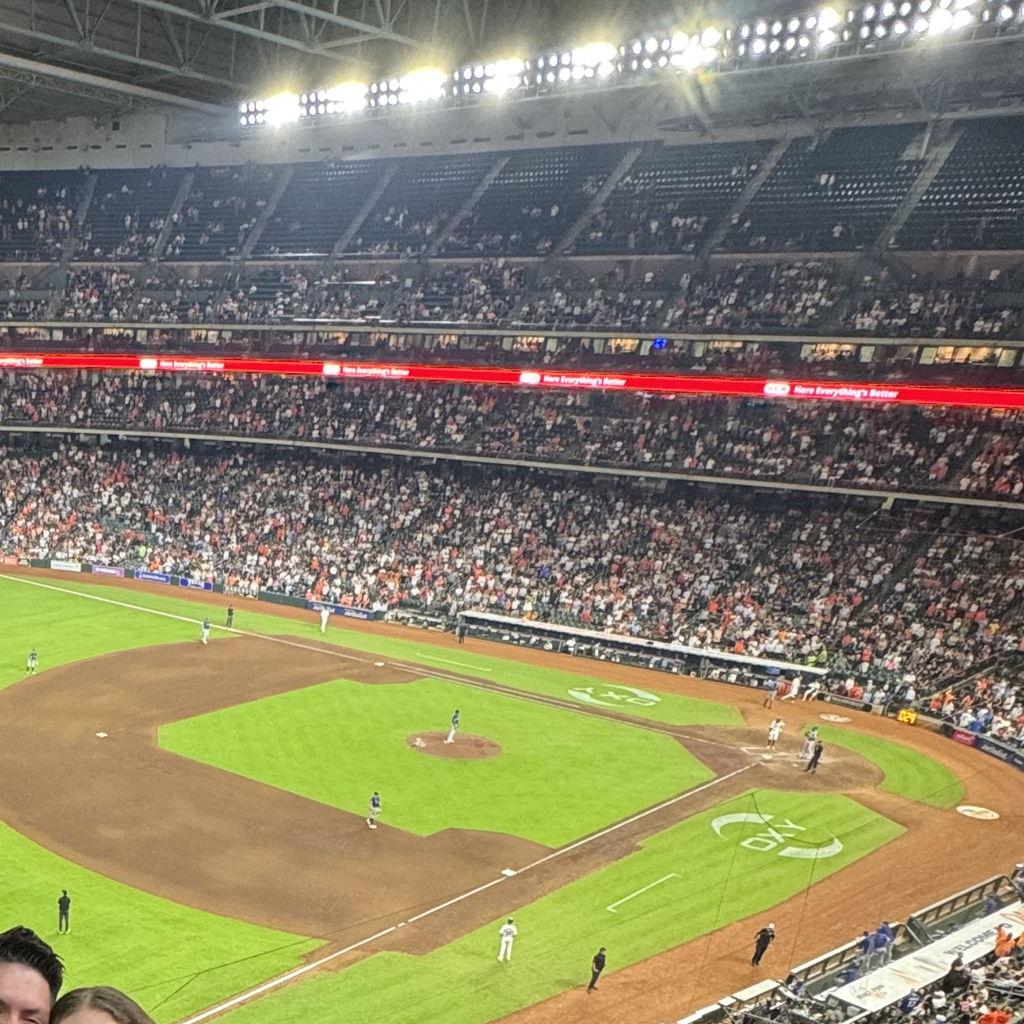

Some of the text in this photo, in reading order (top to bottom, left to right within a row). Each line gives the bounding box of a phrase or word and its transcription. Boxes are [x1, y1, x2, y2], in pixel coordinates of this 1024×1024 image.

[794, 385, 815, 394] Here
[815, 386, 868, 398] Everything's
[869, 388, 899, 398] Better
[943, 929, 995, 955] WELCOME
